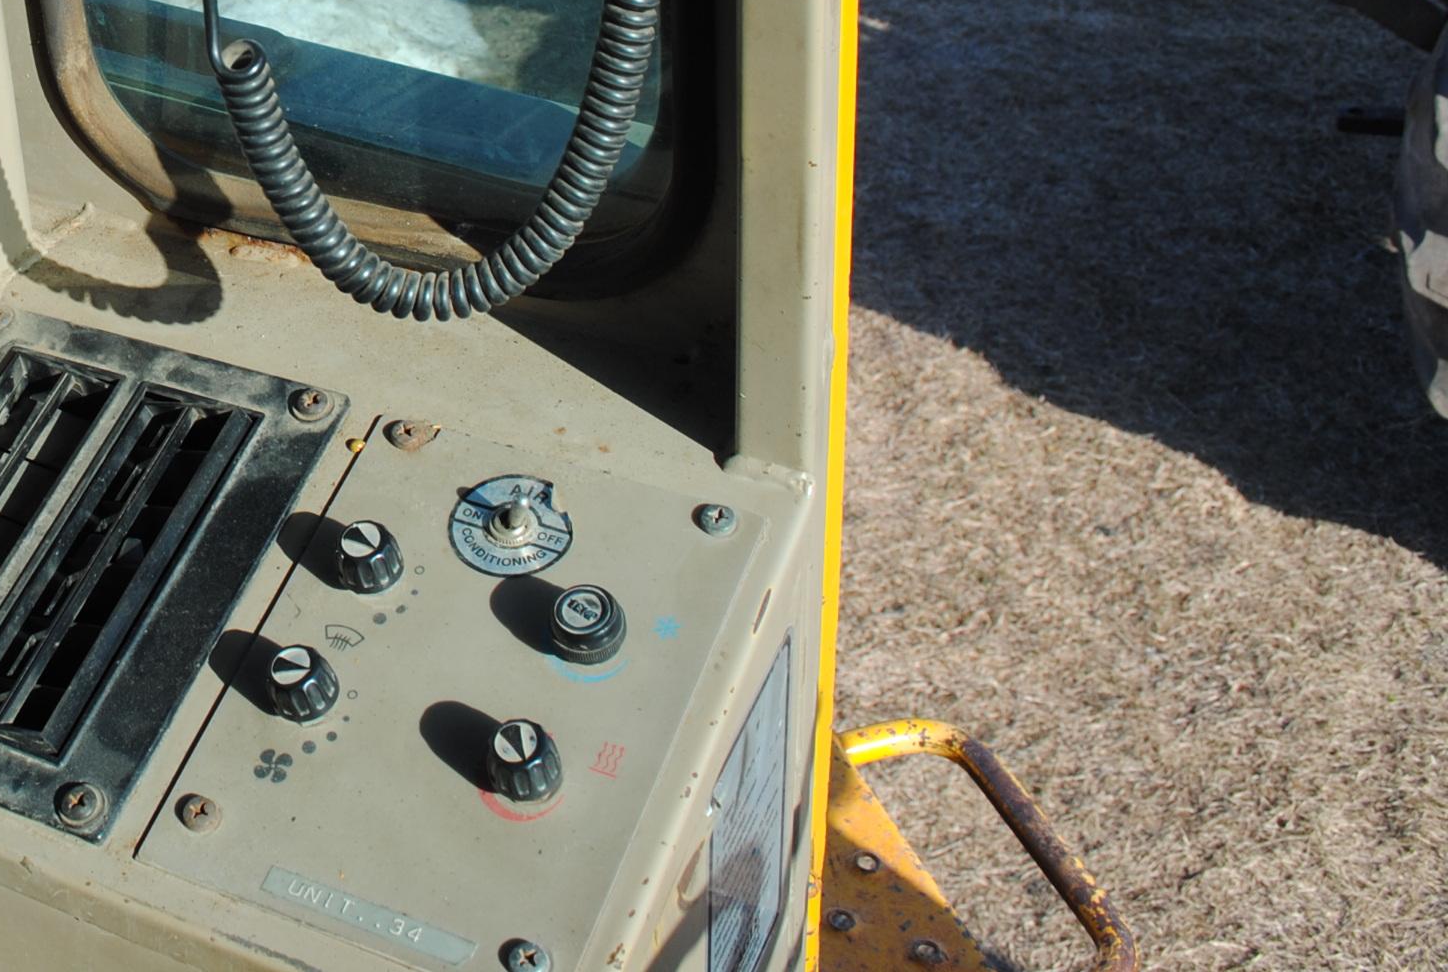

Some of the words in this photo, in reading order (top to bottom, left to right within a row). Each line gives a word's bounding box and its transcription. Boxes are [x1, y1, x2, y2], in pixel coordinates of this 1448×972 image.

[509, 483, 550, 505] AIR
[462, 507, 483, 520] ON
[462, 527, 547, 567] CONDITIONING
[537, 531, 564, 546] OFF
